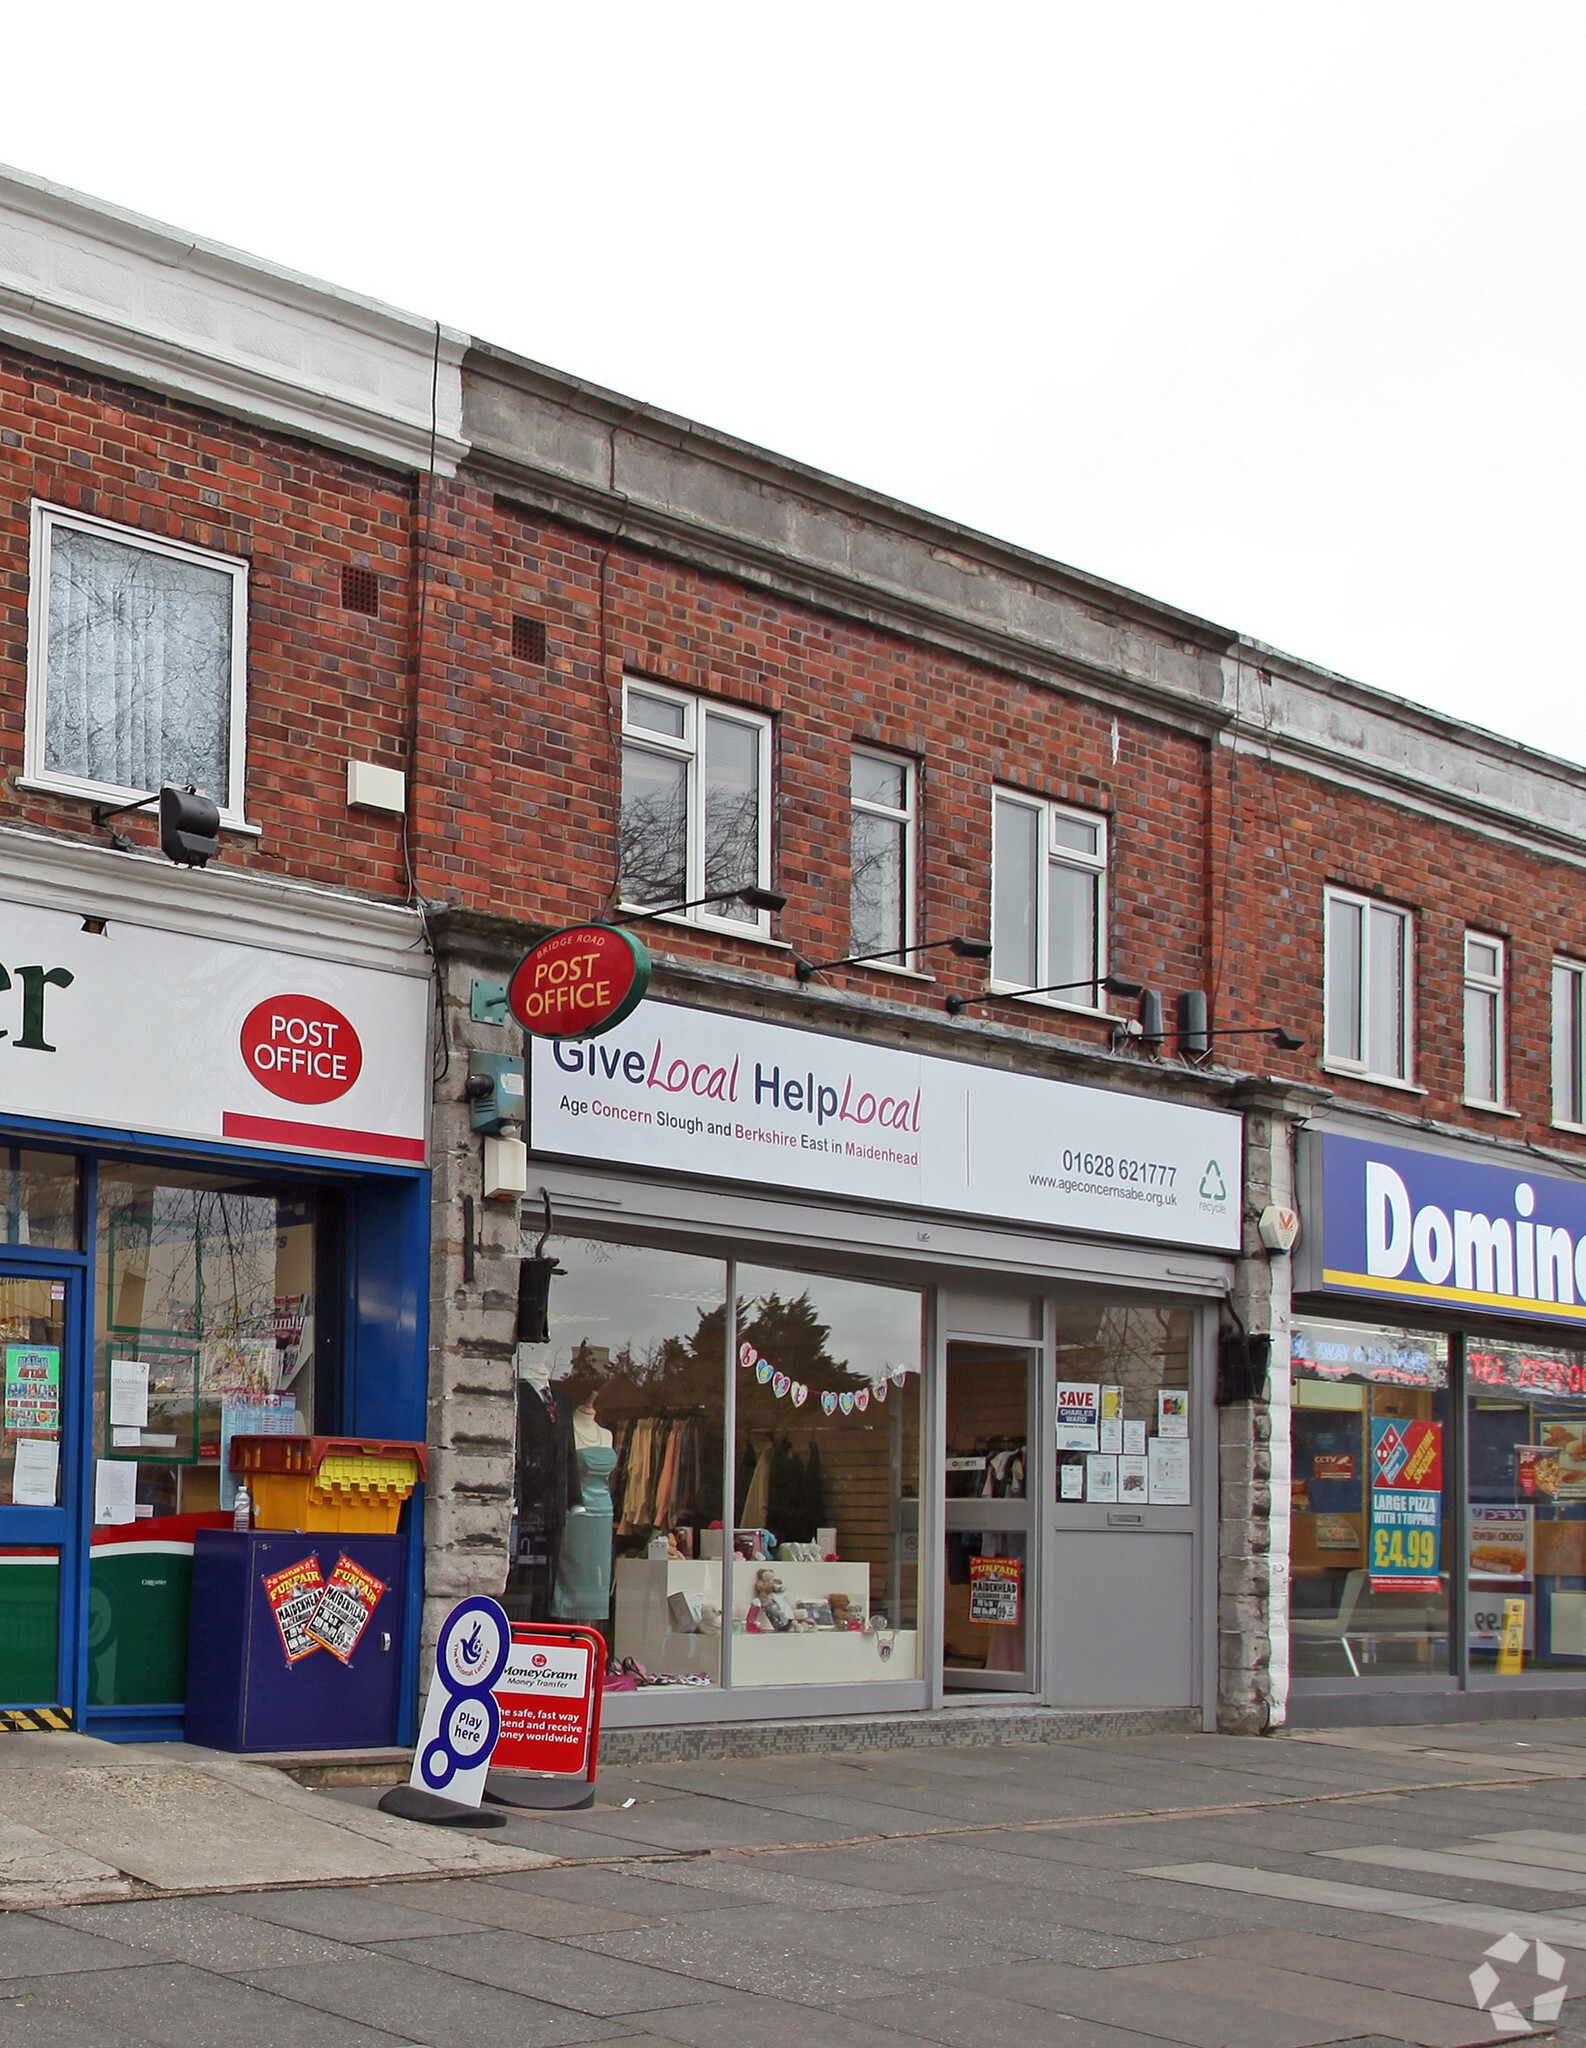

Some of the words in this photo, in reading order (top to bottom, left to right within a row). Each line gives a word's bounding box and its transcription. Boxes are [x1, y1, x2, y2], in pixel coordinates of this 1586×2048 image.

[536, 935, 573, 959] BRIDGE
[576, 934, 605, 946] ROAD
[534, 953, 600, 988] POST
[0, 962, 75, 1052] r
[525, 980, 611, 1017] OFFICE
[271, 1015, 339, 1049] POST
[254, 1043, 348, 1080] OFFICE
[560, 1095, 588, 1115] Age
[591, 1100, 652, 1124] Concern
[656, 1111, 703, 1134] Slough
[707, 1121, 731, 1136] and
[735, 1124, 797, 1147] Berkshire
[800, 1135, 829, 1152] East
[831, 1140, 842, 1154] in
[845, 1142, 918, 1165] Maidenhead
[1063, 1150, 1114, 1178] 01628
[1118, 1159, 1177, 1187] 621777
[1029, 1174, 1177, 1207] www.ageconcernsabe.org.uk
[1199, 1202, 1227, 1215] recycle
[1366, 1161, 1586, 1305] Domin
[1059, 1391, 1093, 1406] SAVE
[1060, 1409, 1093, 1417] CHARLES
[1374, 1494, 1407, 1511] LARGE
[1408, 1496, 1436, 1513] PIZZA
[1373, 1511, 1396, 1524] WITH
[1397, 1512, 1402, 1524] 1
[1402, 1513, 1436, 1526] TOPPING
[1374, 1529, 1436, 1568] £4.99
[970, 1564, 1018, 1577] FUNFAIR
[270, 1571, 321, 1602] FUNFAIR
[334, 1568, 378, 1606] FUNFAIR
[277, 1590, 324, 1620] MAIDENHEA
[324, 1585, 367, 1623] MAIDENHEAD
[454, 1658, 473, 1676] National
[474, 1649, 490, 1674] Lottery
[507, 1677, 535, 1688] Money
[536, 1680, 568, 1688] Transfer
[458, 1712, 483, 1730] Play
[500, 1707, 511, 1716] he
[512, 1709, 536, 1719] safe,
[538, 1710, 557, 1720] fast
[559, 1714, 580, 1724] way
[501, 1720, 525, 1728] send
[526, 1721, 546, 1730] and
[547, 1723, 583, 1733] receive
[454, 1724, 480, 1742] here
[500, 1731, 525, 1742] oney
[526, 1732, 579, 1744] worldwide
